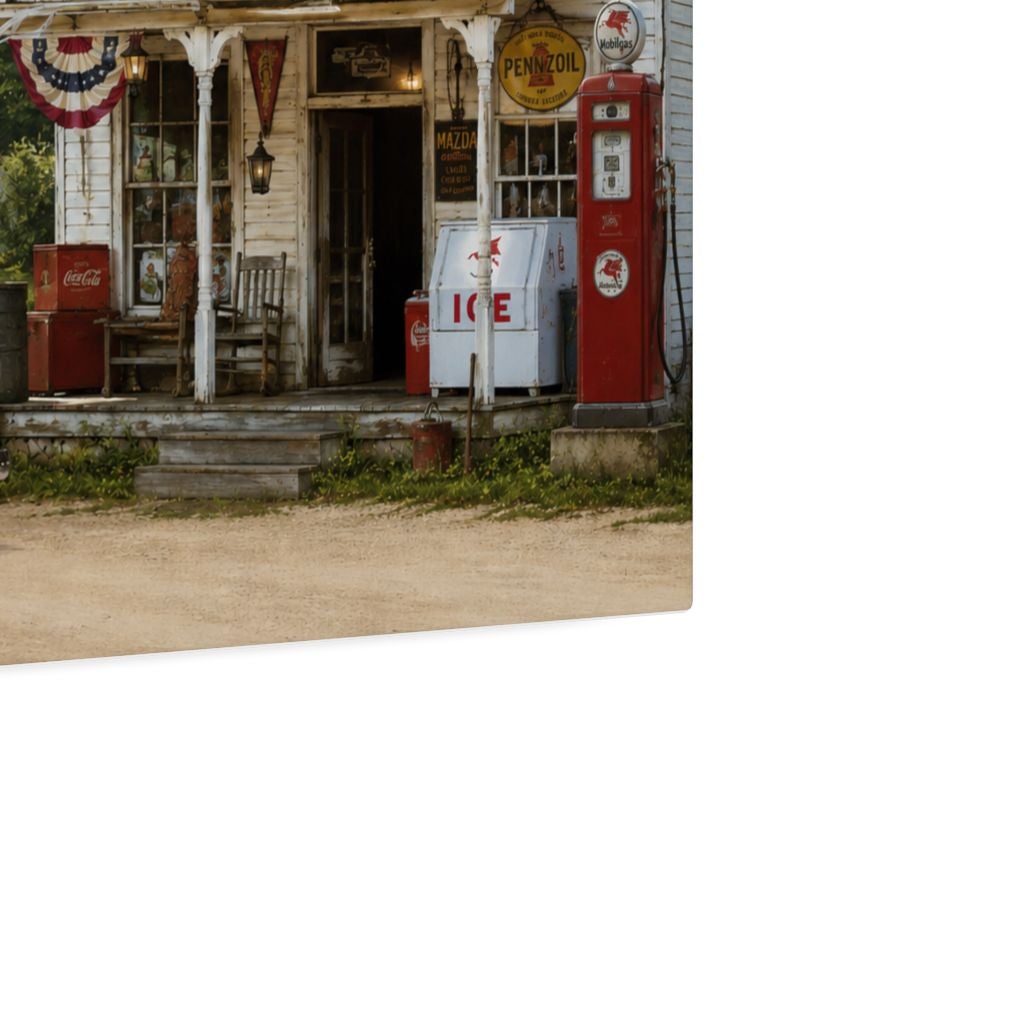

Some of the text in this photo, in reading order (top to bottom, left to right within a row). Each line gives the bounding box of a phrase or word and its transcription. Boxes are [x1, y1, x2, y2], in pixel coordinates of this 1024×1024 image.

[599, 36, 633, 52] Mobilgas
[503, 52, 580, 80] PENNZOIL
[436, 130, 477, 150] MAZDA
